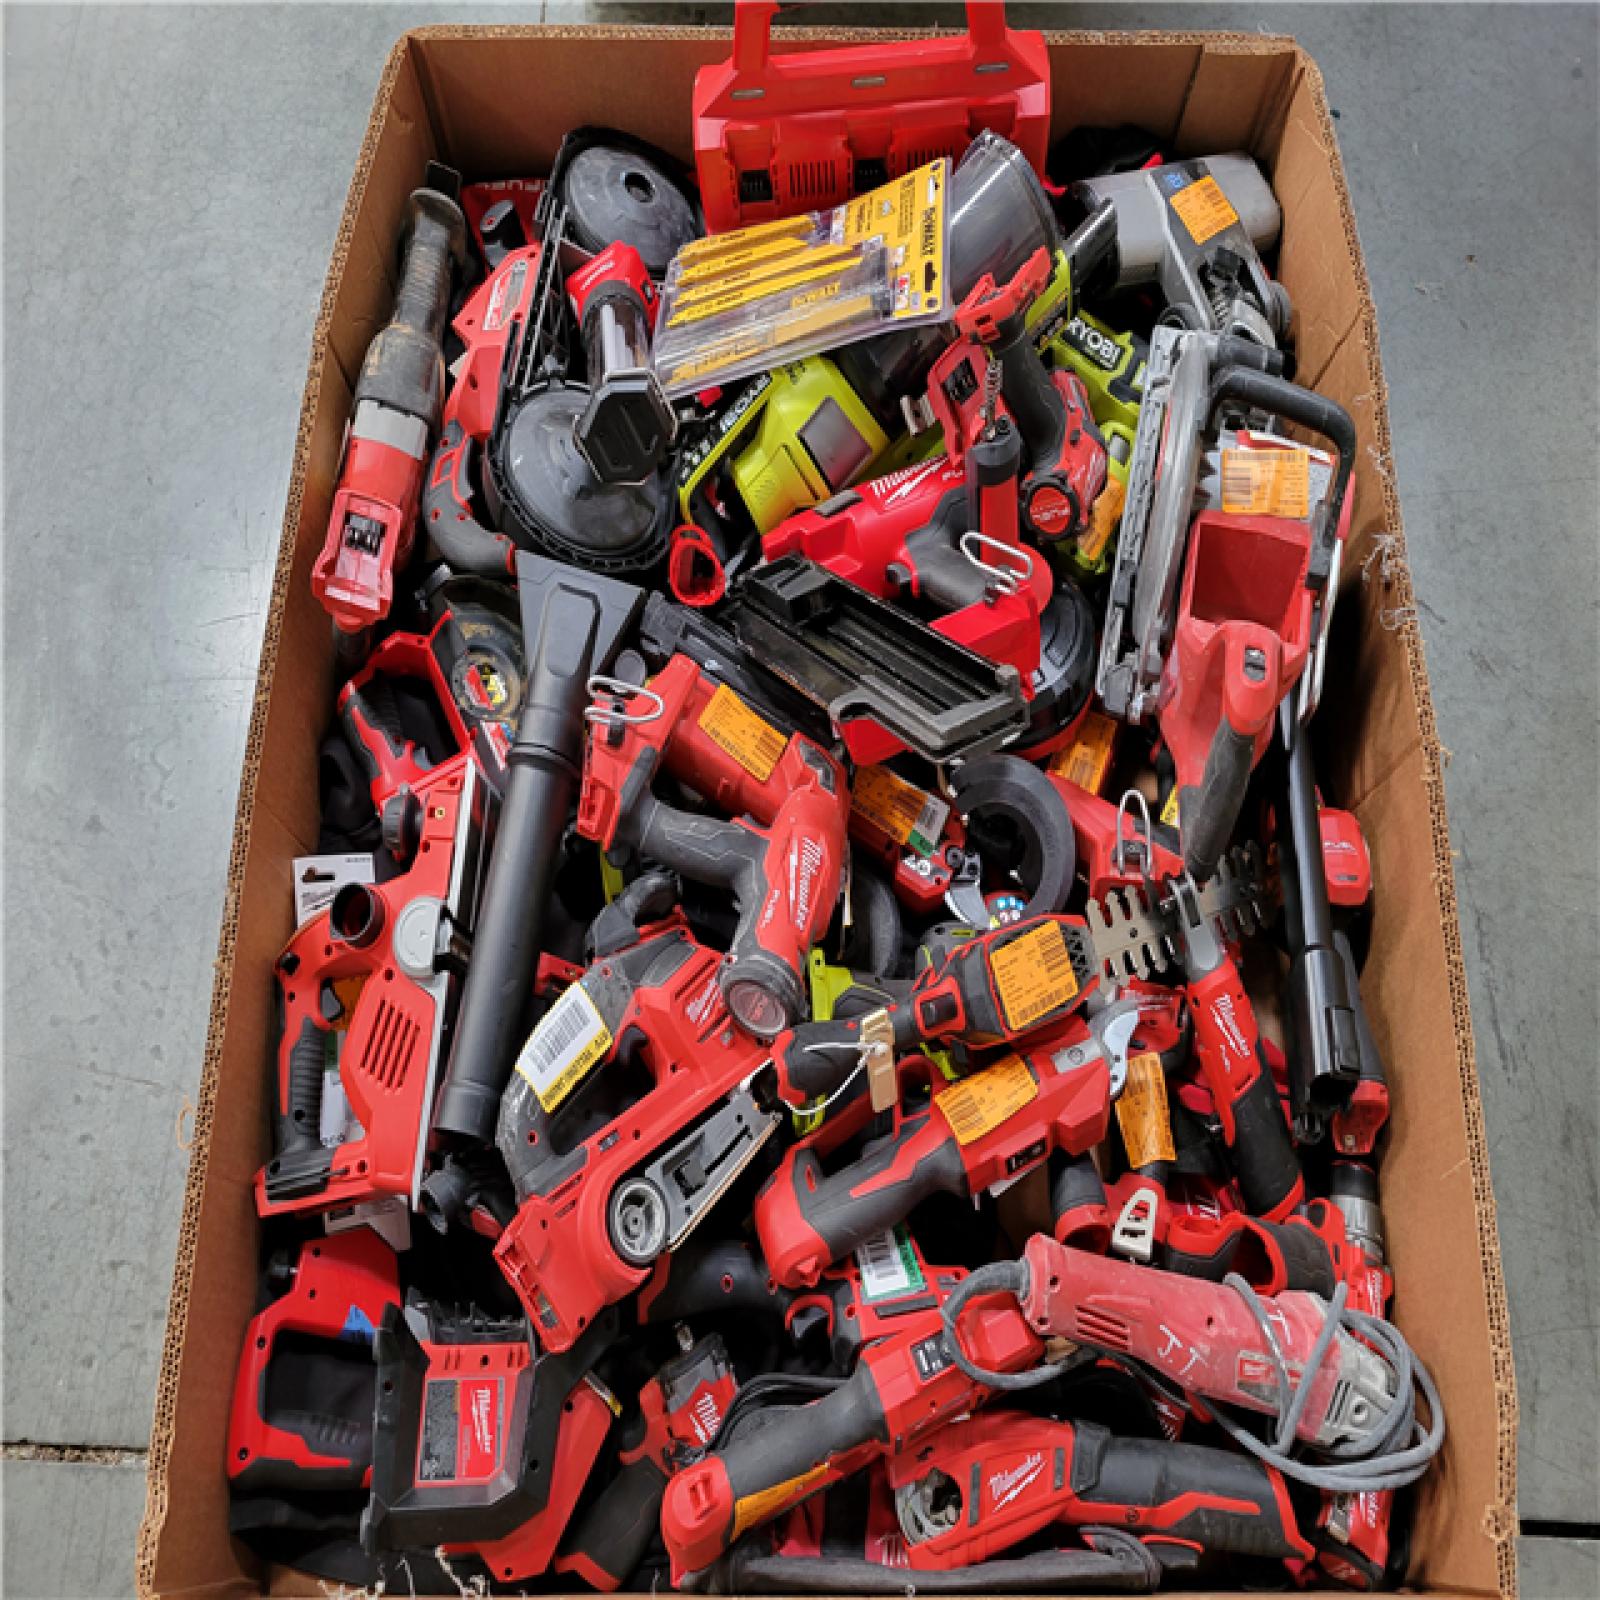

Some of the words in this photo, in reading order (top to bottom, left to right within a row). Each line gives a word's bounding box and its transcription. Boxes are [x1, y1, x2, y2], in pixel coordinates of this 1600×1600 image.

[796, 837, 823, 931] Milwaukee
[1213, 993, 1251, 1057] Milwaukee
[475, 1388, 494, 1455] Milwaukee
[988, 1450, 1043, 1501] Milwaukee
